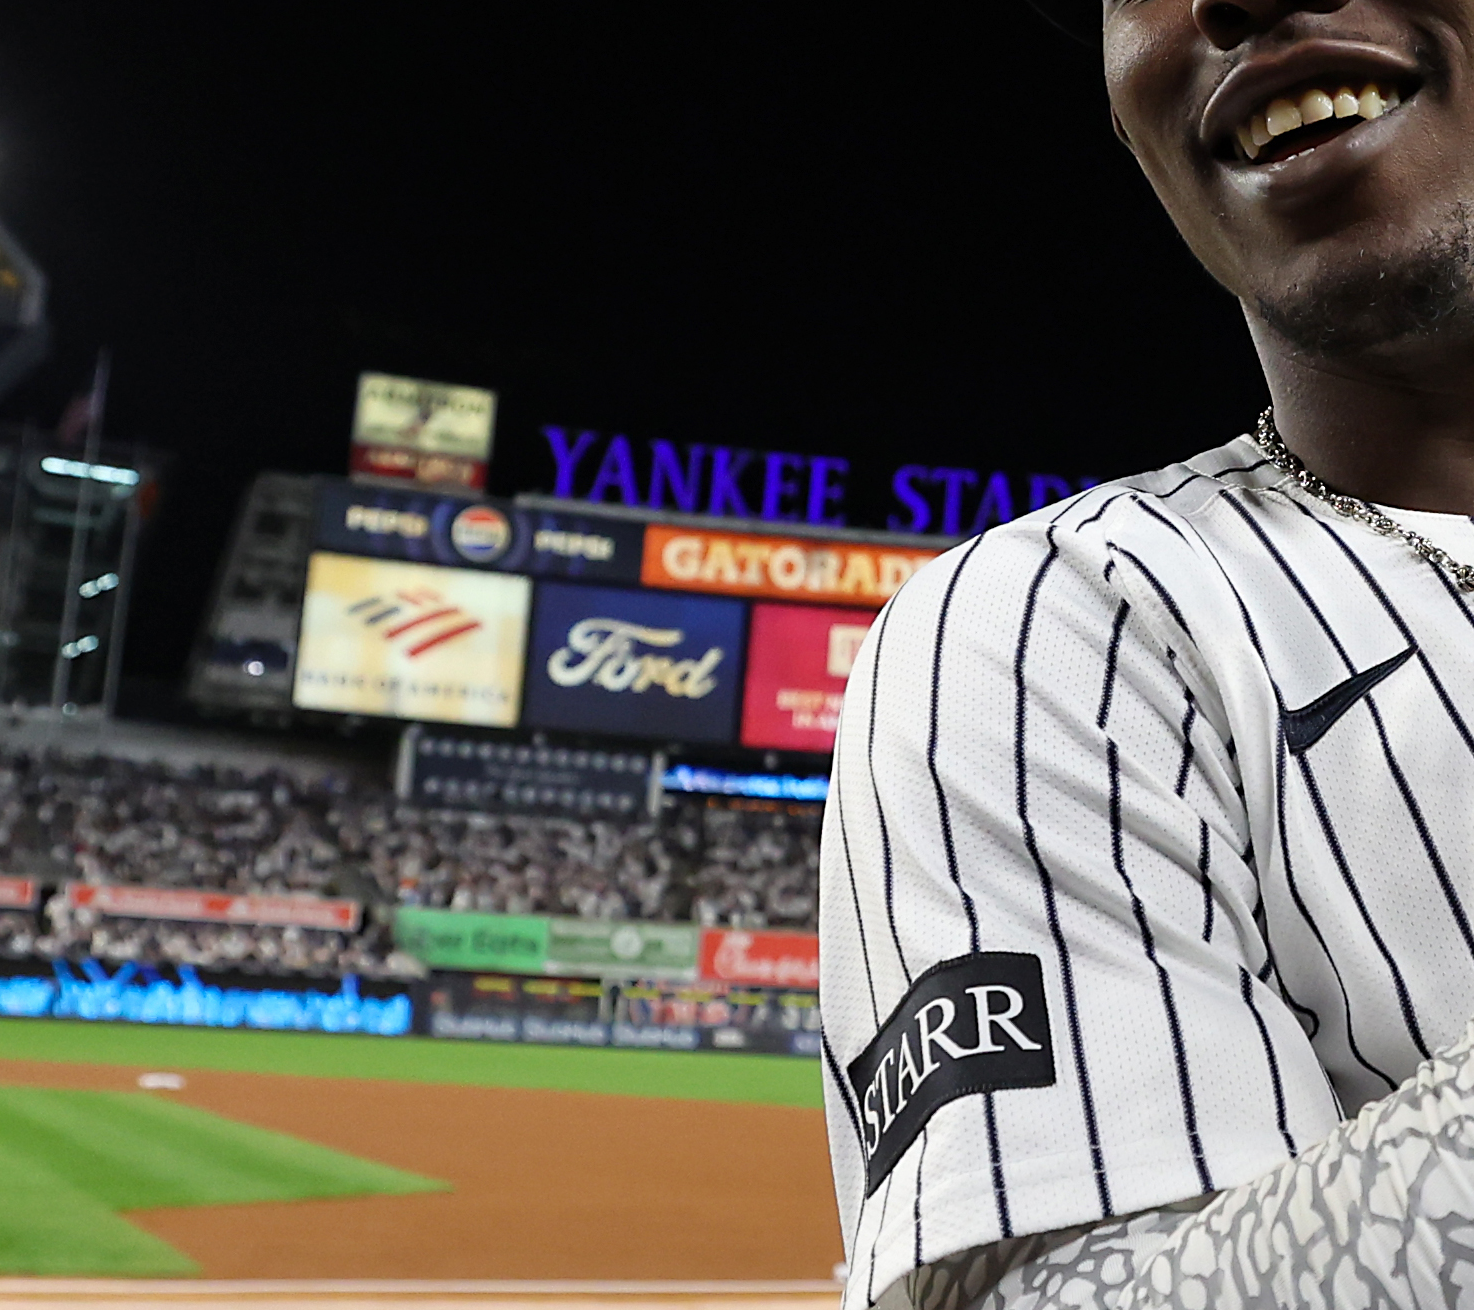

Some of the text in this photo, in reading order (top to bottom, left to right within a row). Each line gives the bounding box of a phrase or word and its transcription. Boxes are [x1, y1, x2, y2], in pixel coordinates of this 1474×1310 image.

[541, 425, 1102, 540] YANKEE STA
[661, 532, 931, 598] GATORAD
[548, 617, 723, 700] Ford
[864, 984, 1043, 1157] STARR
